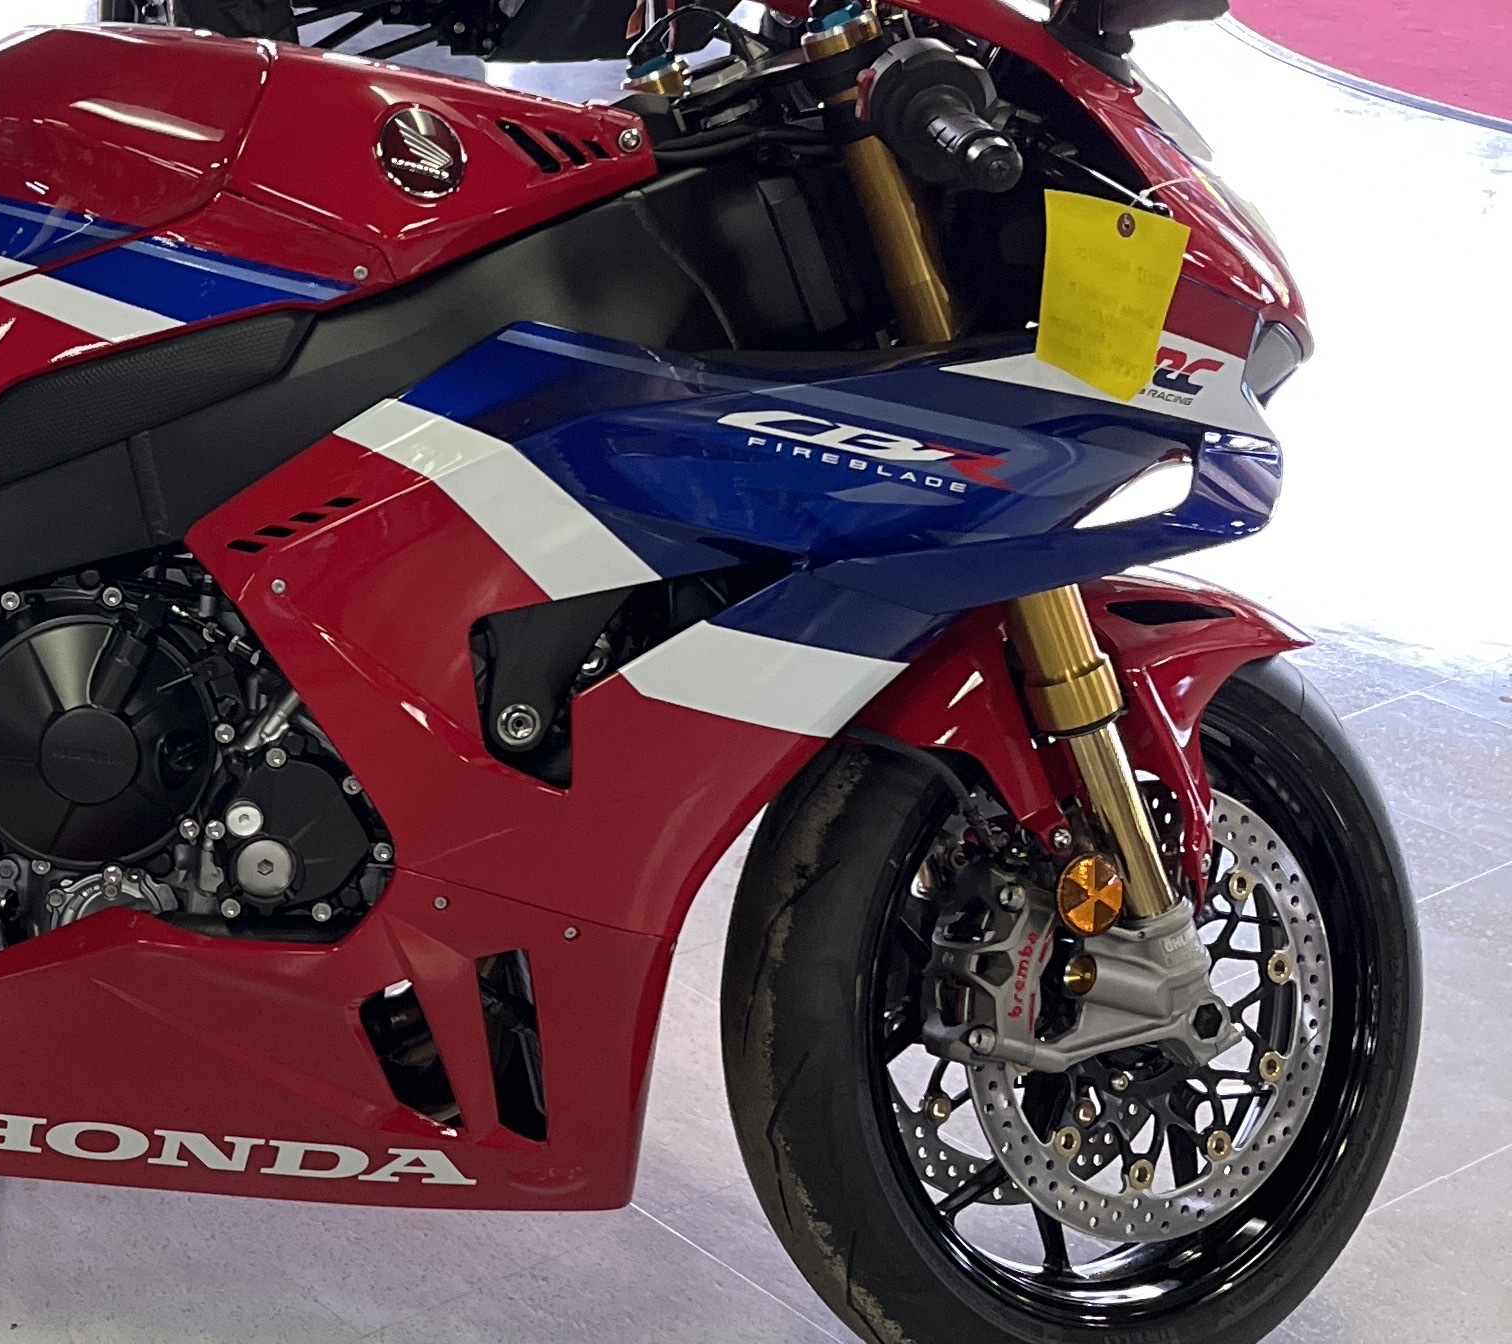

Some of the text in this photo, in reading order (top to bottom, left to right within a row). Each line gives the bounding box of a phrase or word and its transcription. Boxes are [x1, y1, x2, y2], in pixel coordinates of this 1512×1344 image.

[1147, 388, 1194, 406] RACING
[747, 436, 967, 493] FIREBLADE
[1007, 931, 1039, 1020] brembo
